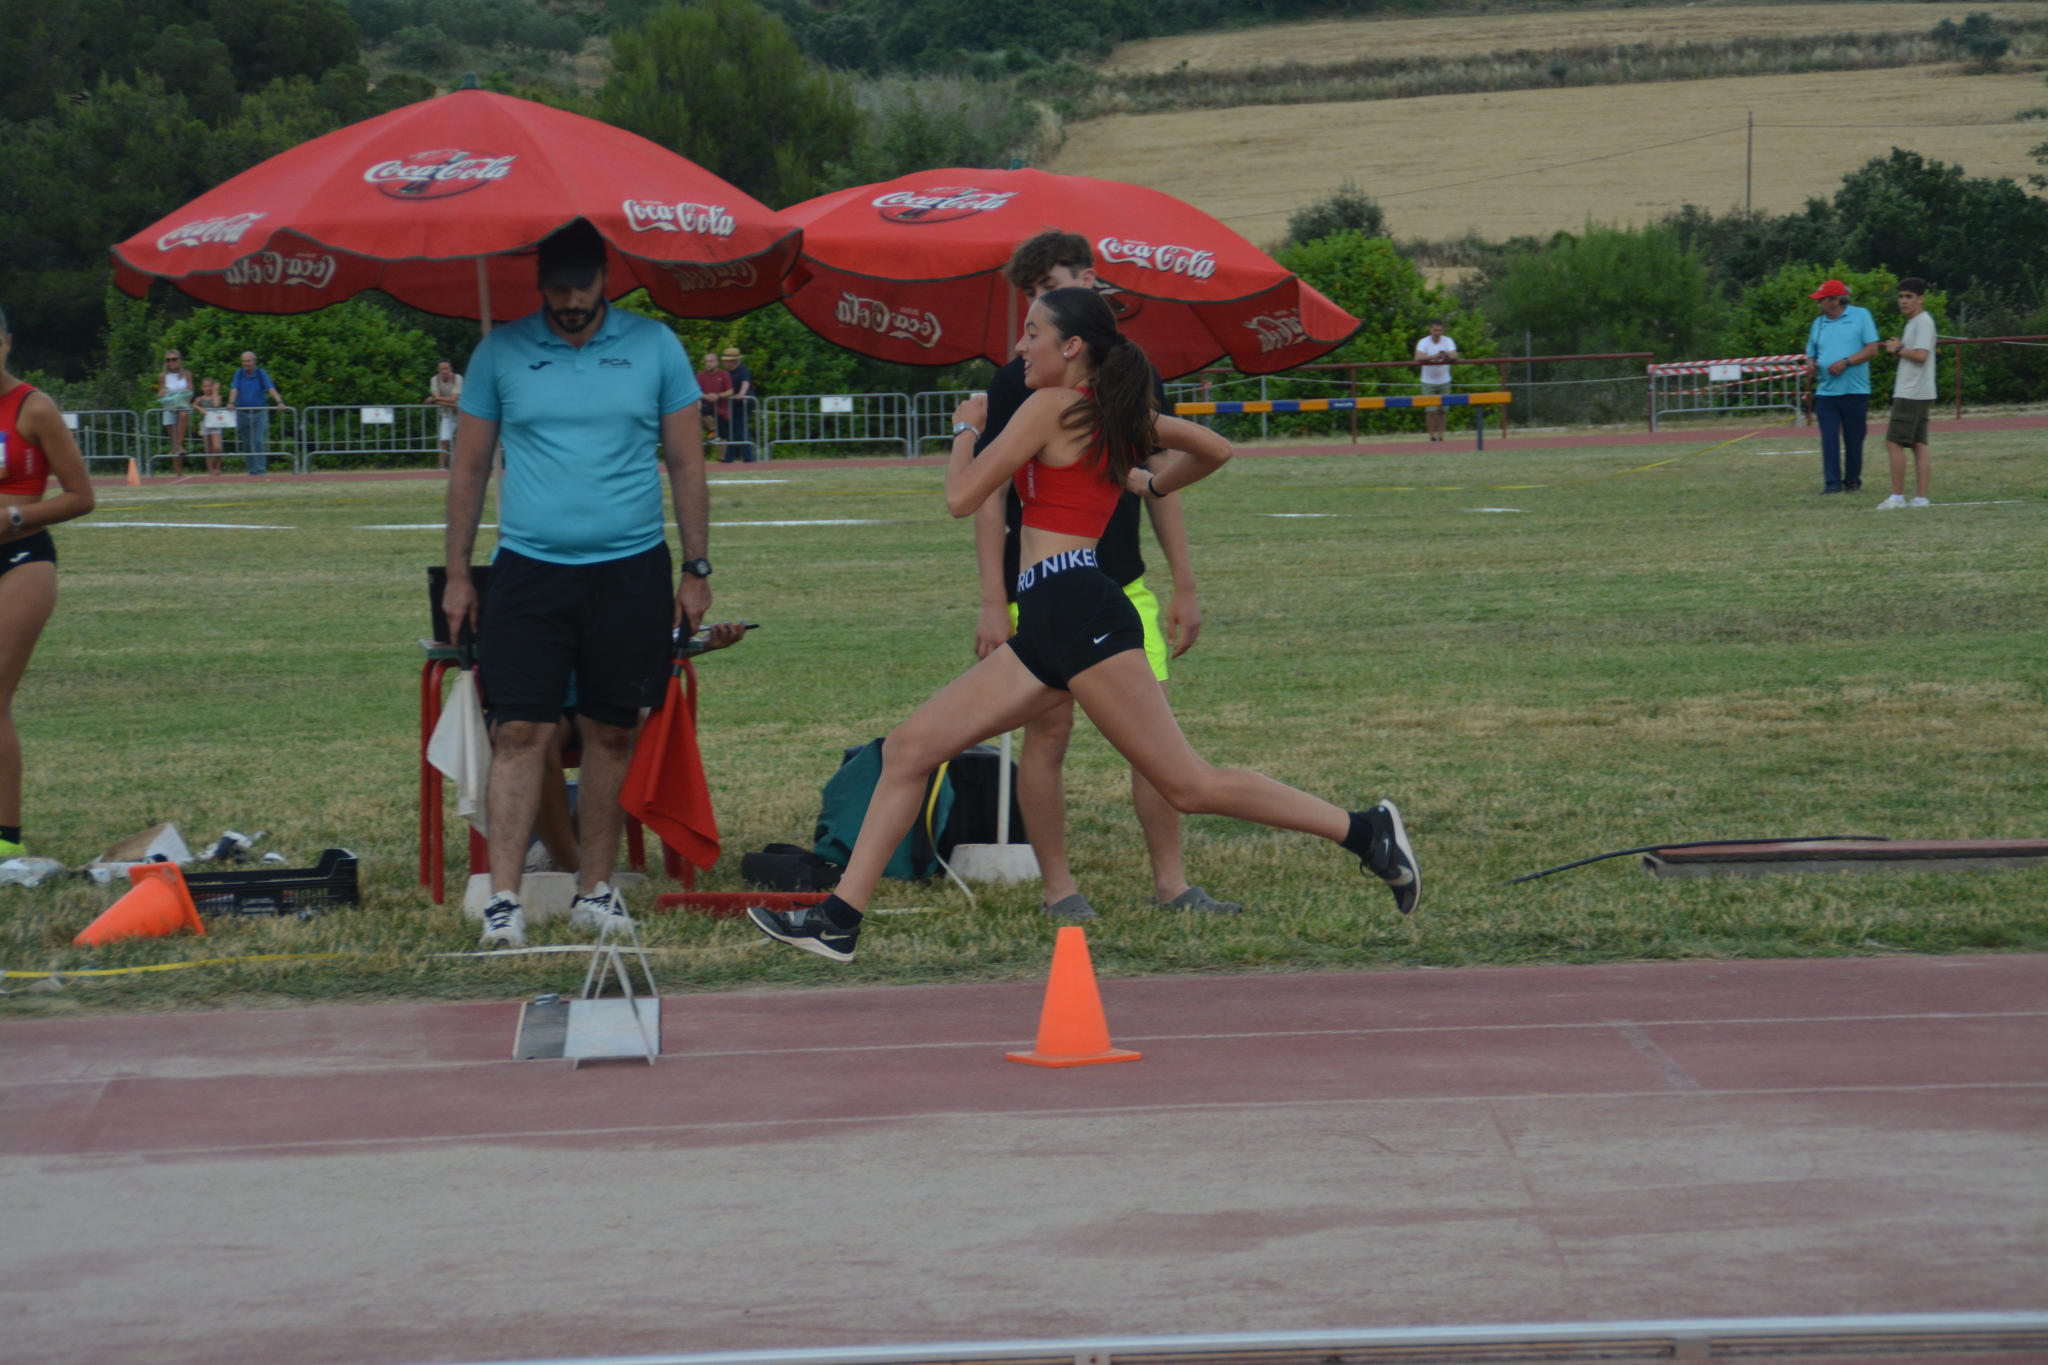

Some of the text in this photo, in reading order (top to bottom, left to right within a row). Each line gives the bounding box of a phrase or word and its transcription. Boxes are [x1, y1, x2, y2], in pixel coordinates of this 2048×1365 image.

[363, 154, 520, 183] Coca-Cola
[622, 199, 737, 236] Coca-Cola
[1098, 237, 1216, 279] Coca-Cola
[1042, 548, 1095, 578] NIKE
